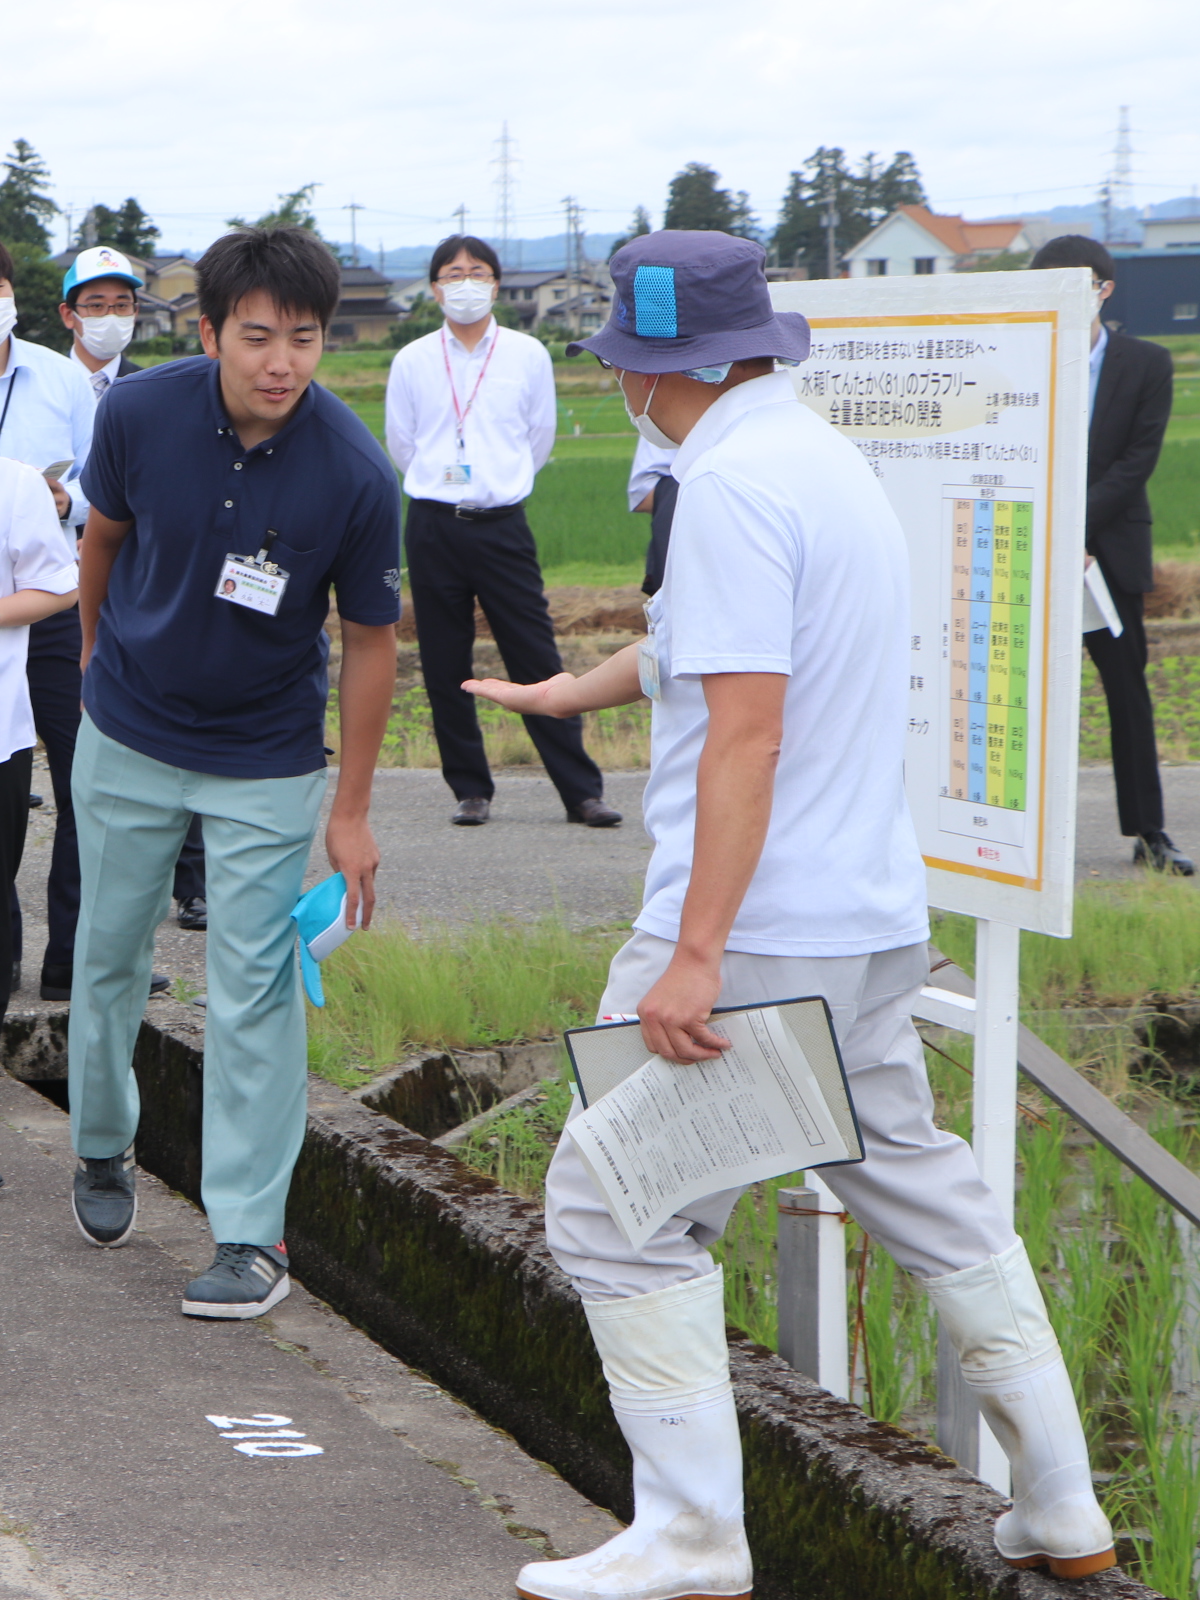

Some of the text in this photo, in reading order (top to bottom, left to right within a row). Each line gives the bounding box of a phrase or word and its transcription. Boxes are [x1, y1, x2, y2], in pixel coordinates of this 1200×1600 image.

[801, 369, 977, 397] 水稲「てんたかく81」のプラフリー
[829, 399, 942, 427] 全量基肥肥料の開発
[853, 440, 1039, 463] れた肥料を使わない水稲早生品種「てんたかく81」
